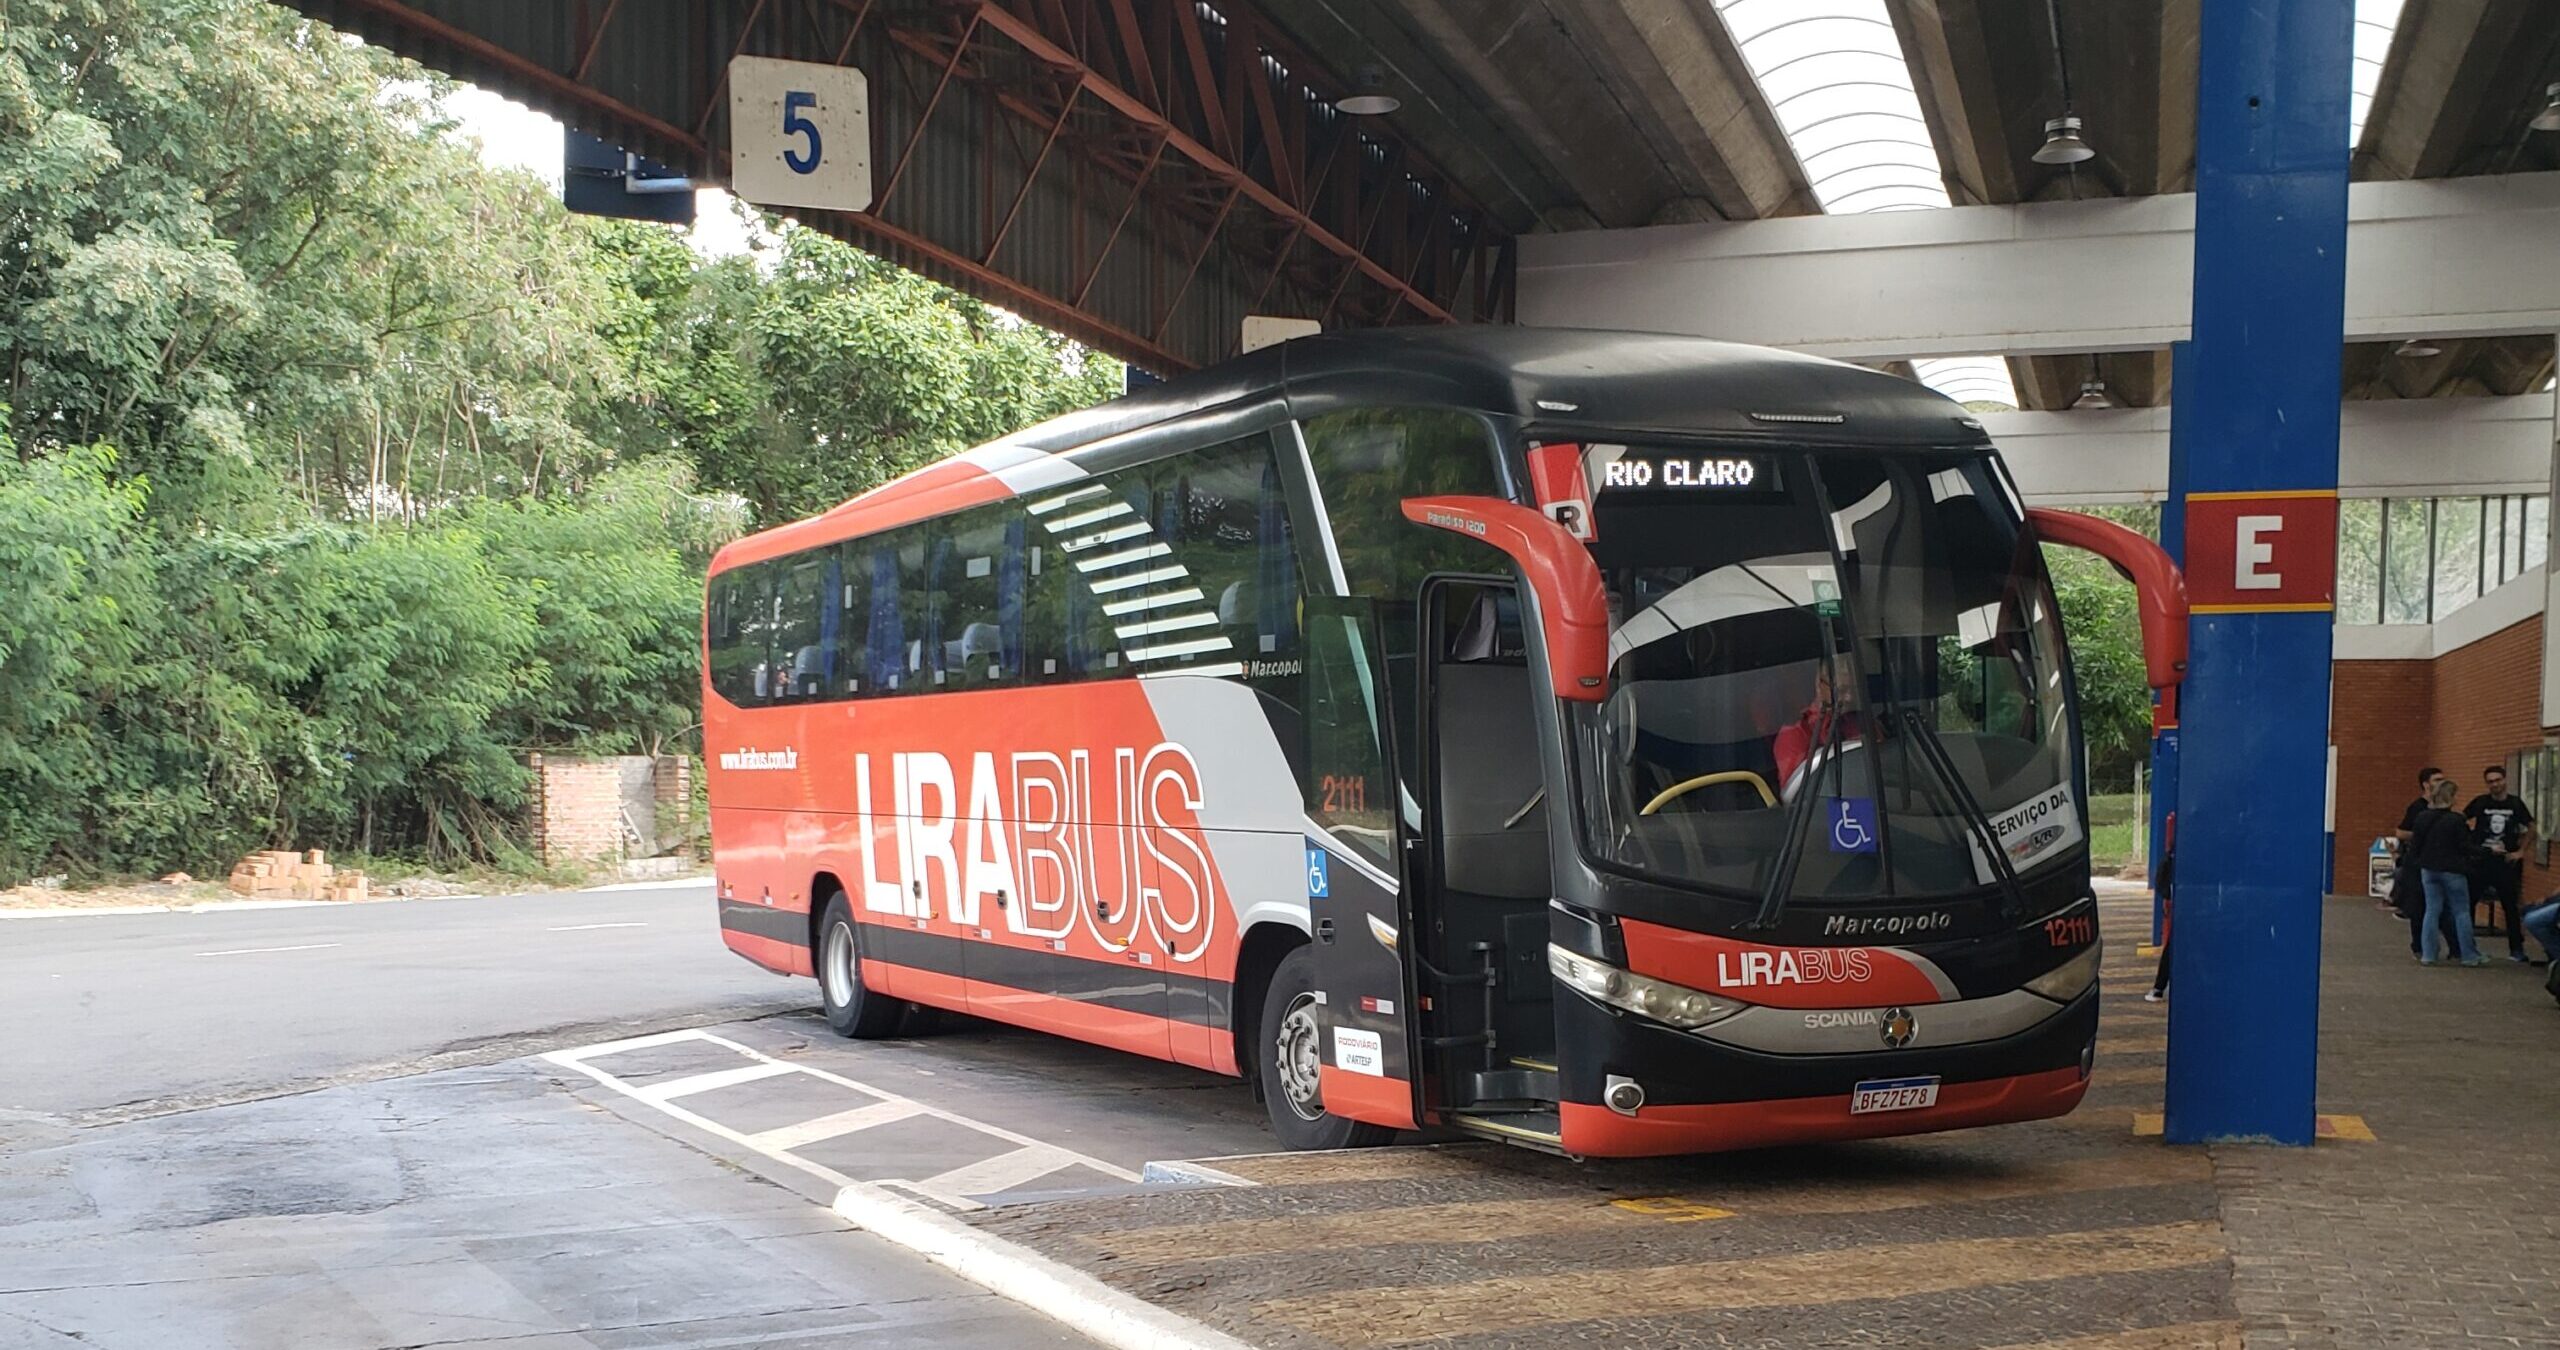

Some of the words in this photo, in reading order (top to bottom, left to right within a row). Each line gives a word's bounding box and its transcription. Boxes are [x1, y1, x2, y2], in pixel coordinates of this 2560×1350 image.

[783, 90, 822, 175] 5
[1605, 460, 1652, 486] RIO
[1663, 459, 1754, 486] CLARO
[1466, 520, 1486, 535] 1200
[1556, 506, 1581, 533] R
[2235, 515, 2283, 589] E
[1251, 659, 1302, 677] Marcopol
[1322, 775, 1365, 813] 2111
[2050, 790, 2069, 810] DA
[855, 741, 1214, 963] LIRABUS
[1824, 911, 1951, 936] Marcopolo
[2044, 916, 2092, 946] 12111
[1718, 947, 1872, 987] LIRABUS
[1804, 1011, 1877, 1029] SCANIA
[1860, 1087, 1928, 1110] BFZ7E78
